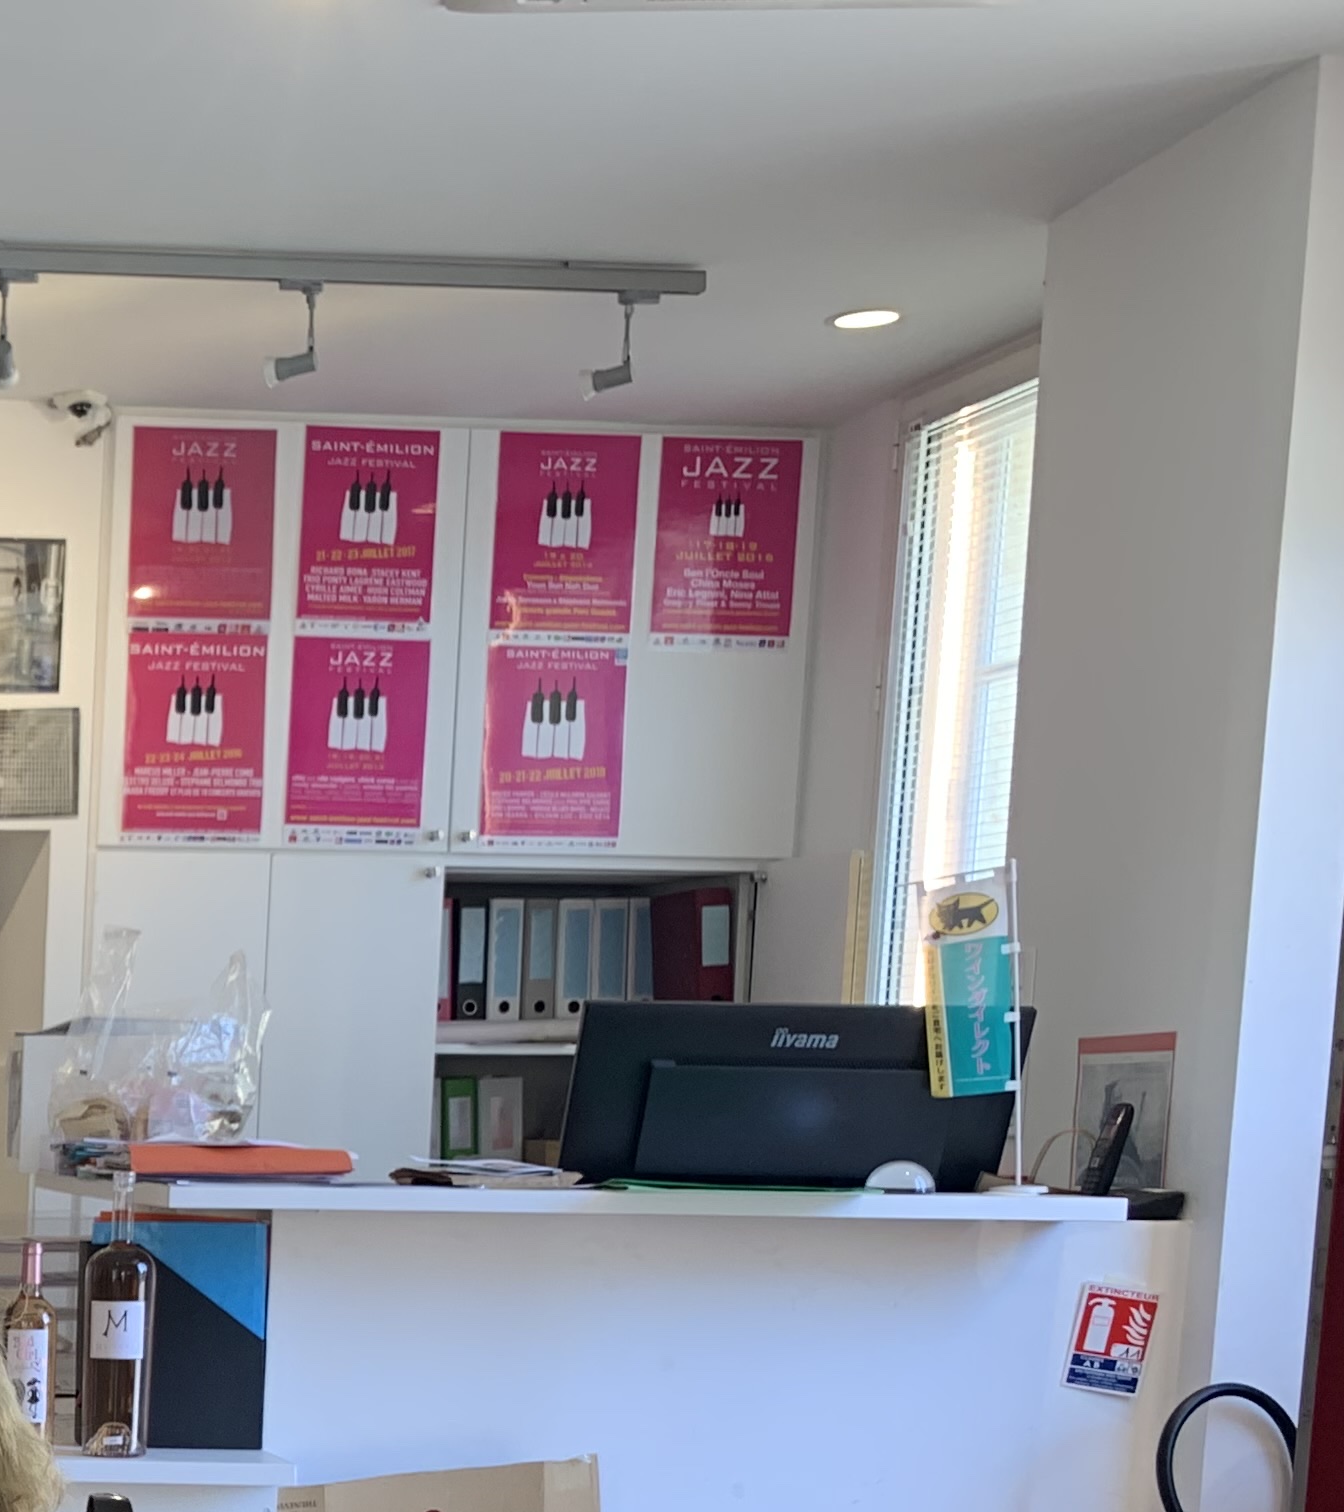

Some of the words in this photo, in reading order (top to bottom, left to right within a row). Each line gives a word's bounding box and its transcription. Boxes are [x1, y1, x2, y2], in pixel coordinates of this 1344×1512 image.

[172, 441, 237, 458] JAZZ
[311, 439, 435, 456] SAINT-ÉMILION
[327, 457, 357, 467] JAZZ
[361, 458, 416, 469] FESTIVAL
[540, 457, 598, 472] JAZZ
[682, 456, 780, 480] JAZZ
[681, 480, 778, 493] FESTIVAL
[129, 642, 265, 658] SAINT-ÉMILION
[506, 647, 610, 661] SAINT-ÉMILION
[147, 660, 182, 672] JAZZ
[185, 661, 246, 672] FESTIVAL
[330, 651, 393, 667] JAZZ
[516, 661, 544, 671] JAZZ
[547, 662, 599, 672] FESTIVAL
[543, 767, 582, 781] JUILLET
[770, 1027, 839, 1050] iiyama
[1088, 1284, 1160, 1302] EXTINCTEUR
[102, 1309, 129, 1337] M
